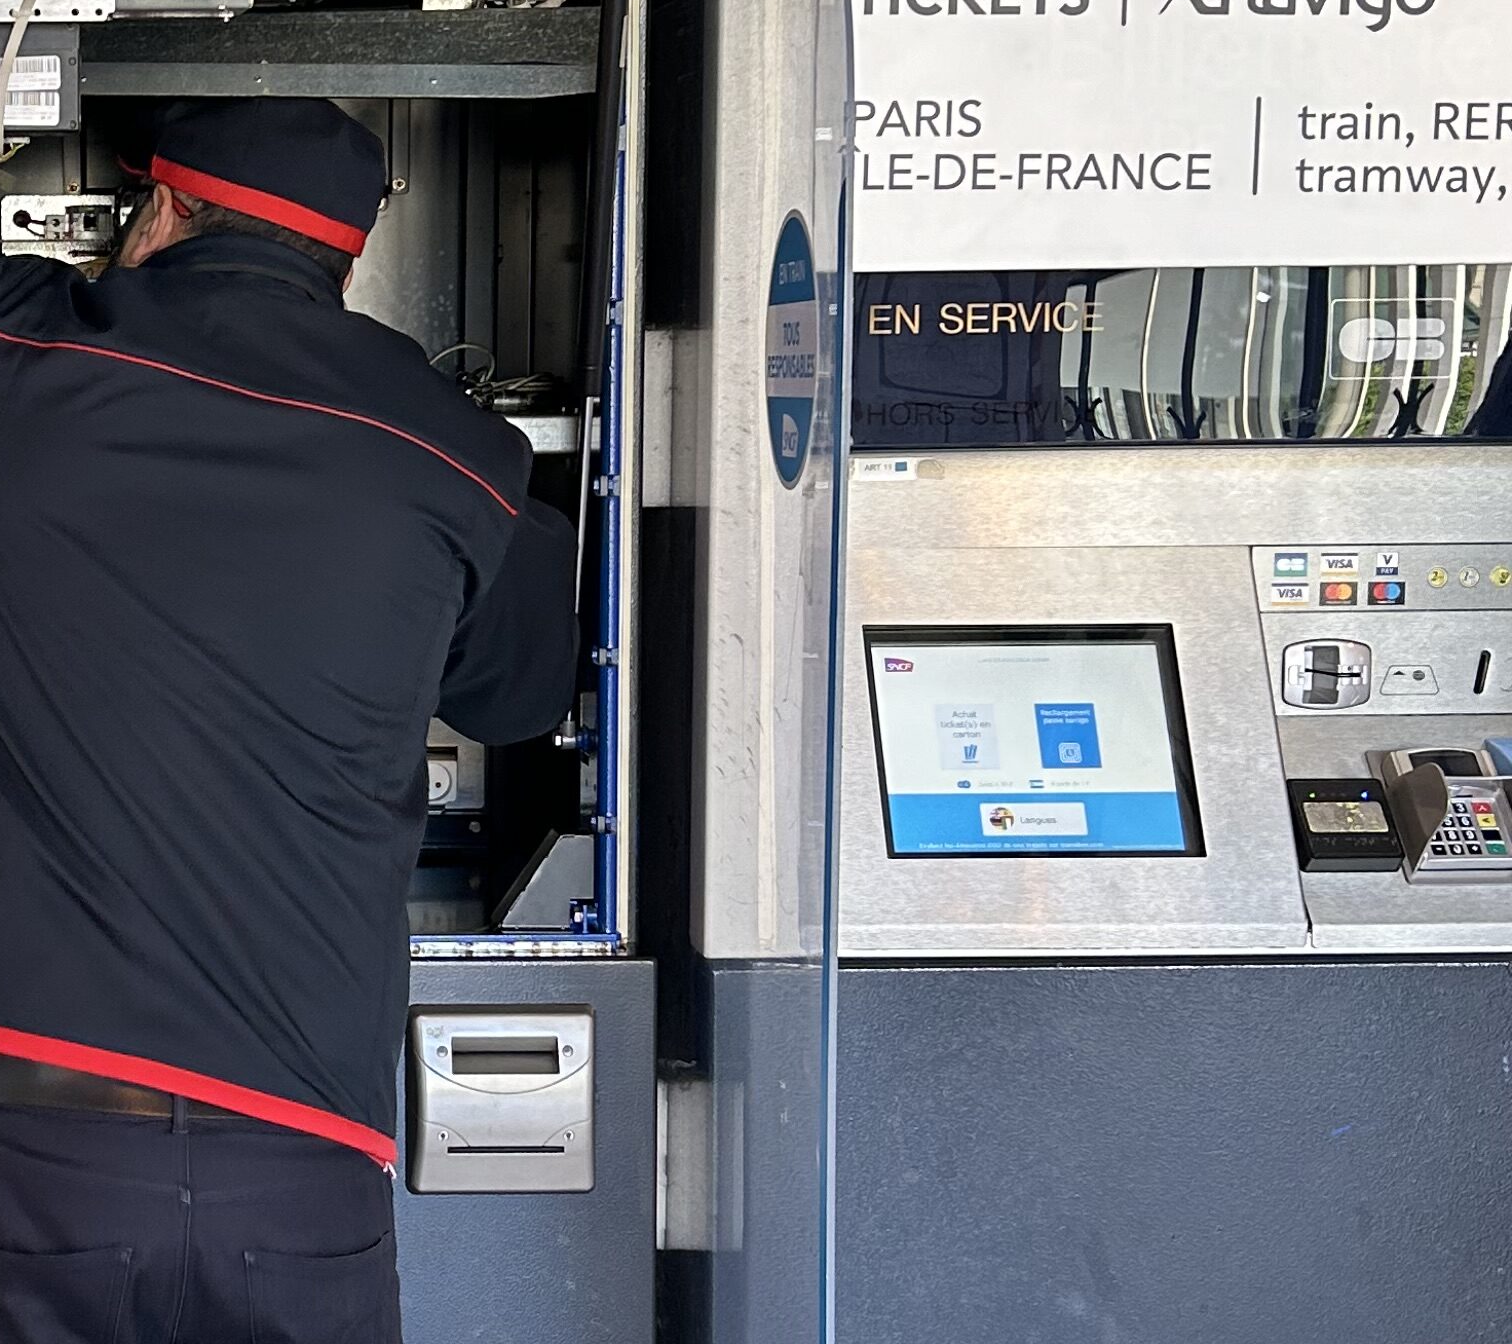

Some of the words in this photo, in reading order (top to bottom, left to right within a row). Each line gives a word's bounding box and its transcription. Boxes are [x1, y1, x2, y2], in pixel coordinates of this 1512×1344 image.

[845, 98, 983, 137] PARIS
[1298, 102, 1416, 145] train,
[1295, 157, 1508, 204] tramway,
[869, 304, 920, 335] EN
[938, 301, 1105, 334] SERVICE
[971, 400, 1096, 426] SERVI
[1327, 558, 1354, 569] VISA
[1278, 588, 1303, 599] VISA
